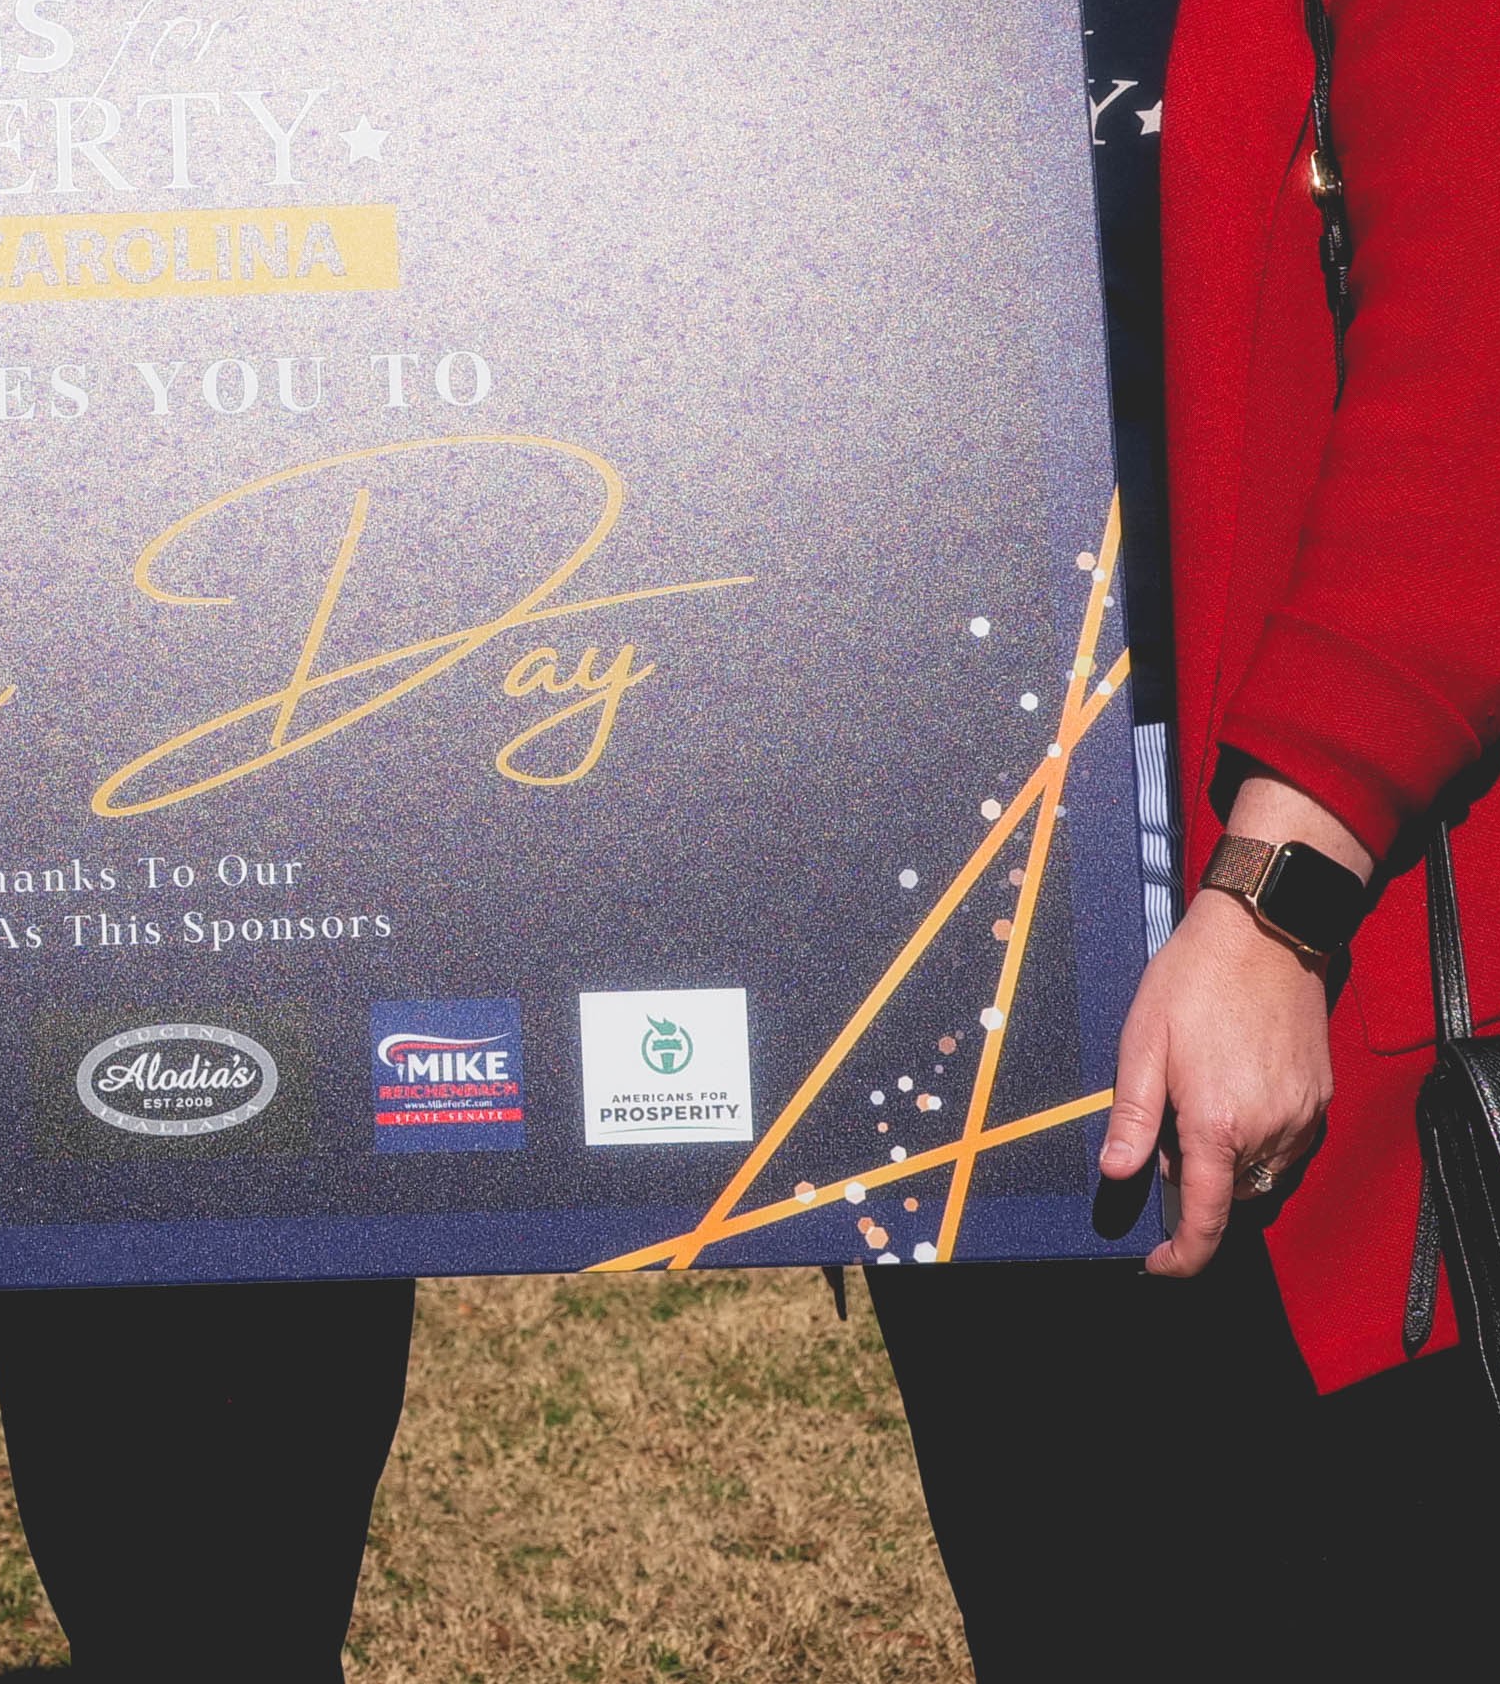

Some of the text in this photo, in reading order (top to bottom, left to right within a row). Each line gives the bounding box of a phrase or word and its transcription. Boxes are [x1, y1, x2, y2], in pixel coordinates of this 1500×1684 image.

[133, 355, 327, 415] YOU
[370, 350, 492, 409] TO
[91, 434, 755, 817] Day
[138, 856, 195, 889] To
[218, 854, 302, 887] Our
[64, 913, 161, 947] This
[183, 911, 392, 952] Sponsors
[115, 1025, 237, 1048] CUCINA
[98, 1052, 257, 1092] Alodia's
[408, 1051, 509, 1083] MIKE
[143, 1096, 214, 1109] EST 2008
[379, 1082, 519, 1100] REICHENBACH
[612, 1091, 728, 1103] AMERICANS FOR
[395, 1111, 504, 1123] STATE SENATE
[600, 1104, 740, 1123] PROSPERITY
